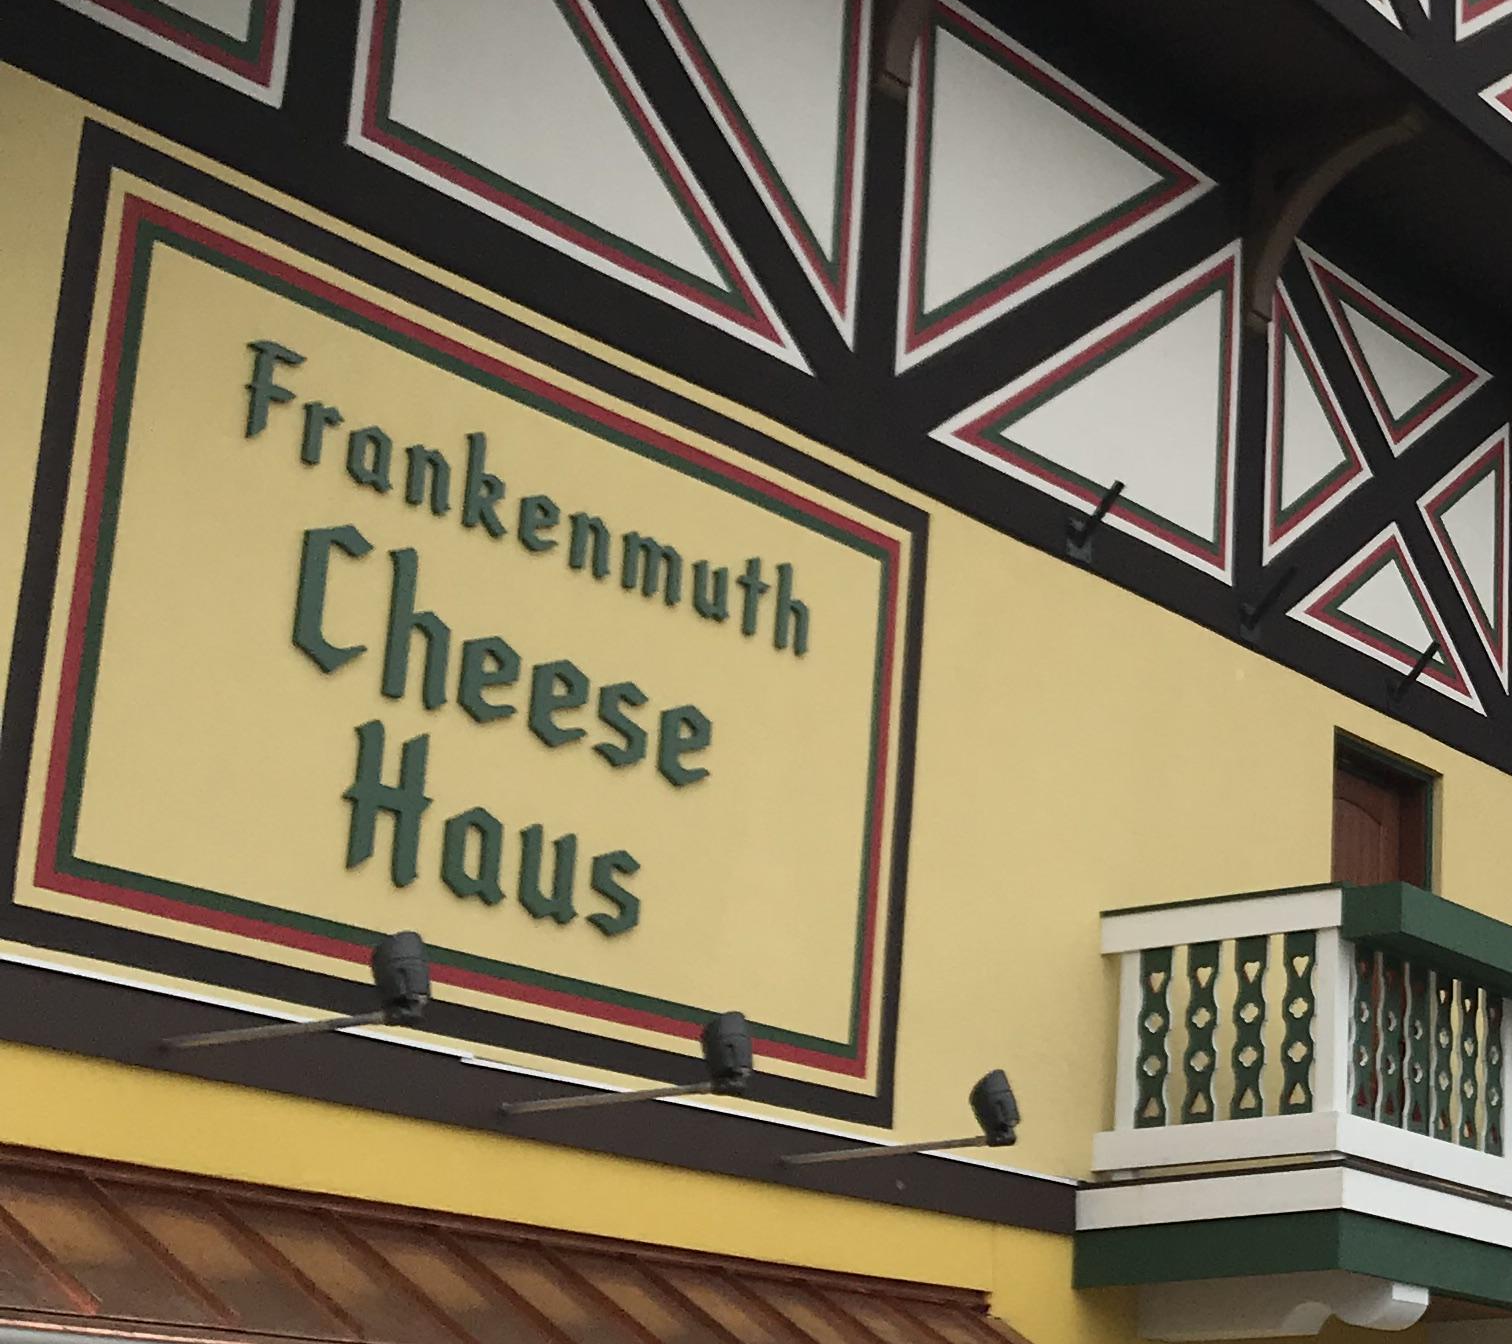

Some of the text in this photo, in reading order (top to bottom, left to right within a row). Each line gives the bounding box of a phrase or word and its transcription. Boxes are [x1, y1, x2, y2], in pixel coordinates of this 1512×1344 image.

[245, 339, 810, 657] Frankenmuth
[291, 523, 713, 789] Cheese
[341, 719, 641, 937] Haus
